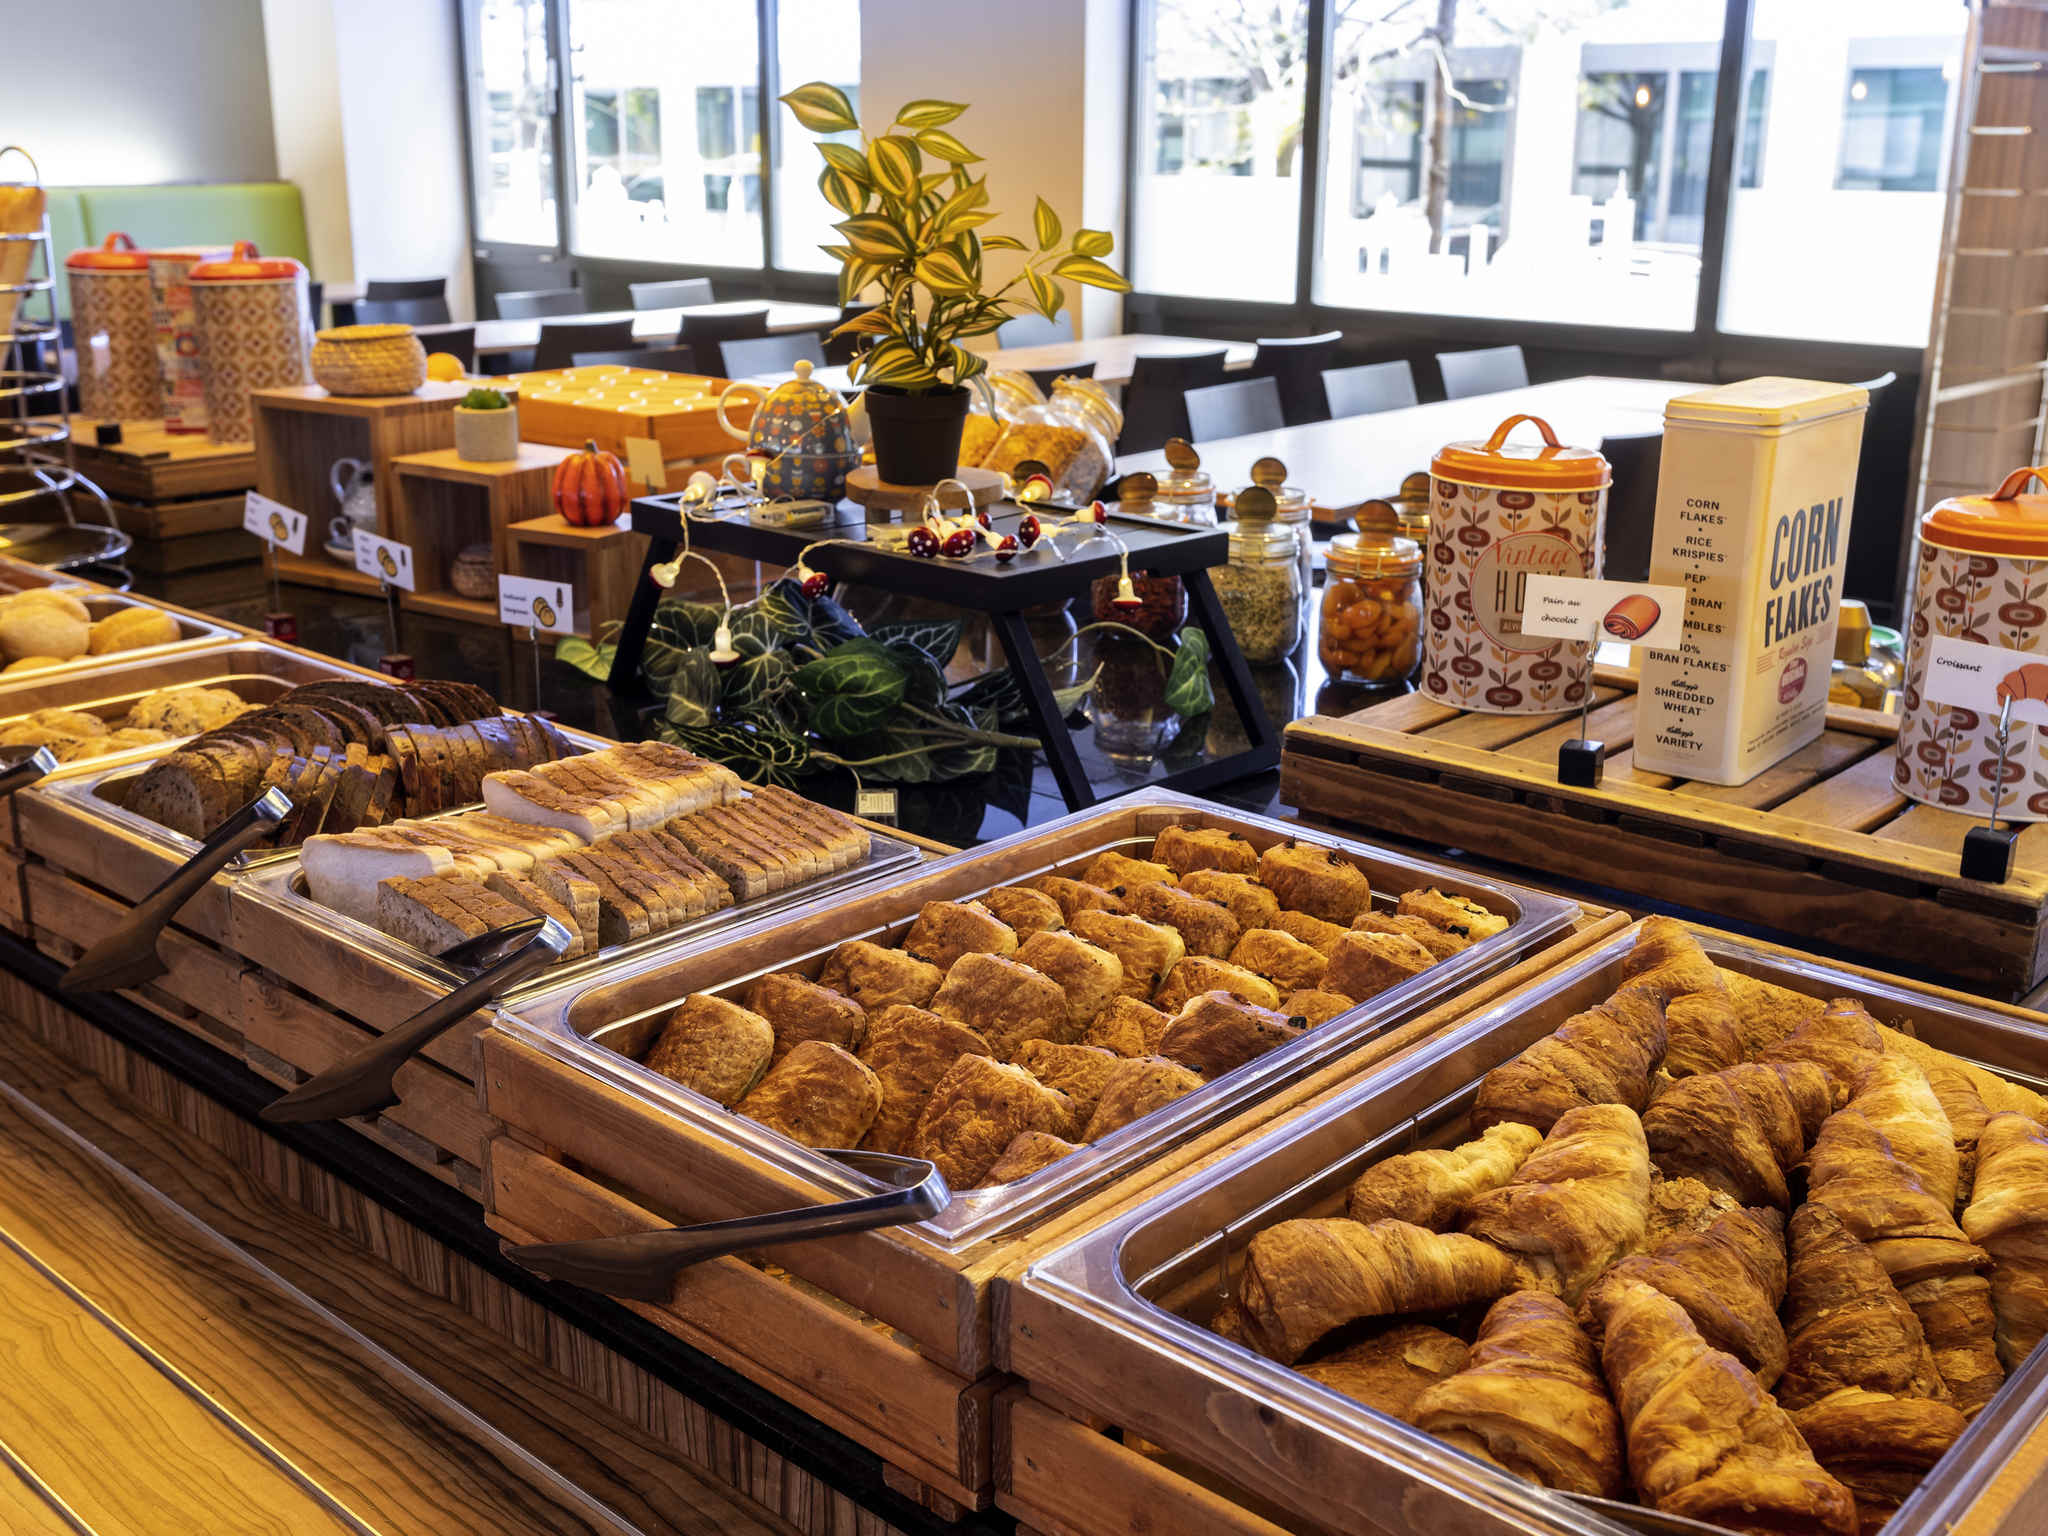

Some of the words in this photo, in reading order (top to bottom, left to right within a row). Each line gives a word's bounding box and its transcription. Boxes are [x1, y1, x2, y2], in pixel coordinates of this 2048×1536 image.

[1686, 498, 1720, 511] CORN
[1680, 511, 1725, 526] FLAKES
[1685, 536, 1713, 548] RICE
[1769, 495, 1844, 591] CORN
[1672, 547, 1725, 563] KRISPIES
[1684, 572, 1707, 584] PEP
[1541, 613, 1580, 625] chocolat
[1764, 573, 1834, 649] FLAKES
[1683, 619, 1723, 634] MBLES
[1649, 650, 1680, 665] BRAN
[1683, 657, 1728, 673] FLAKES
[1936, 656, 1984, 673] Croissant
[1654, 686, 1715, 706] SHREDDED
[1663, 701, 1702, 717] WHEAT
[1655, 734, 1704, 752] VARIETY
